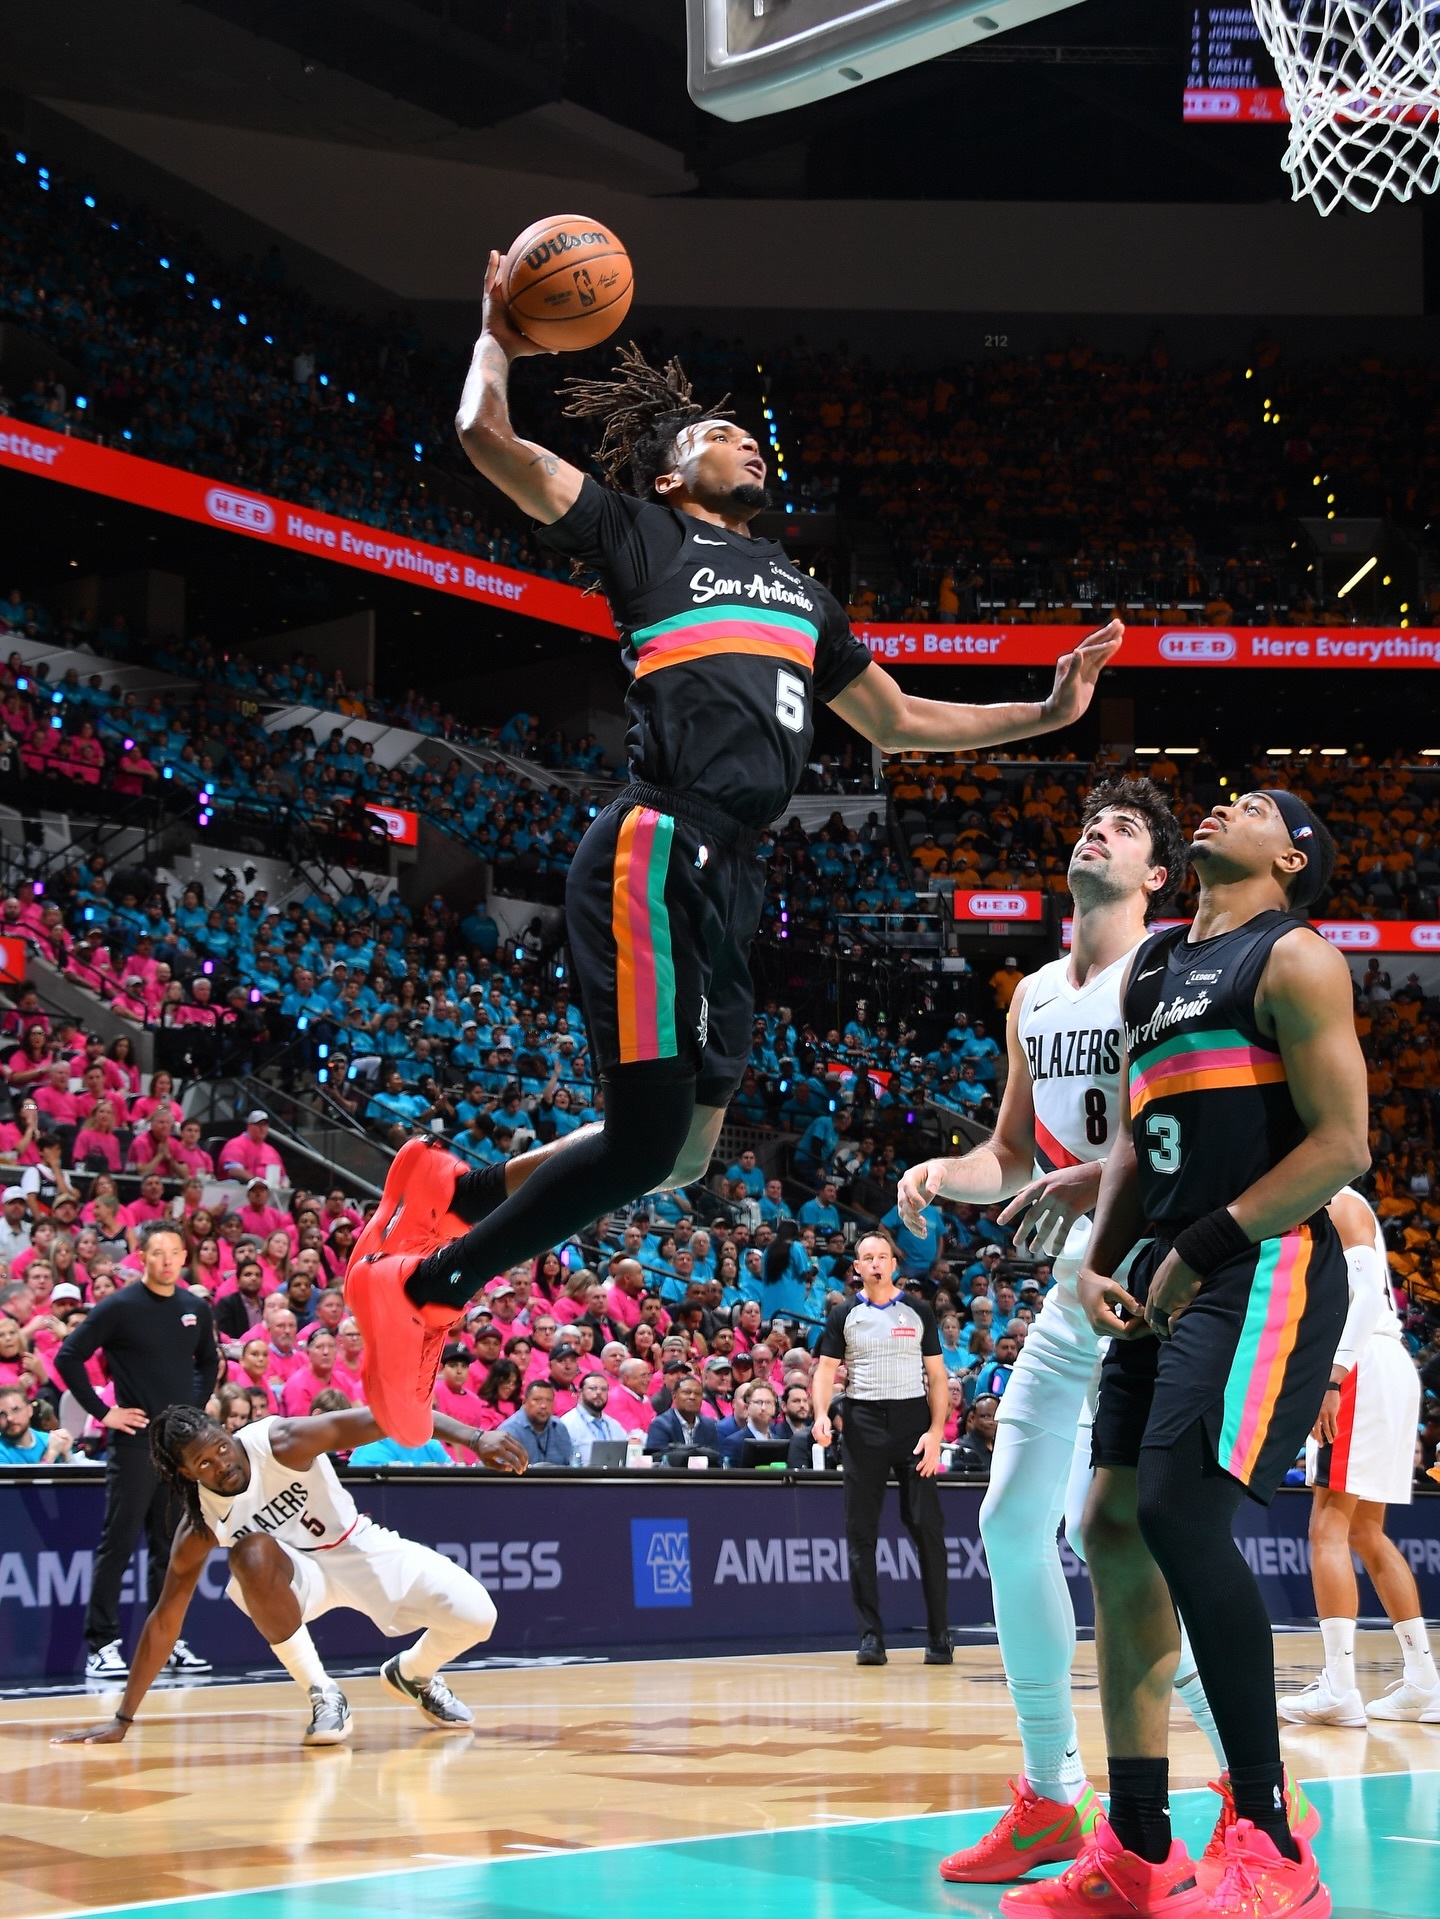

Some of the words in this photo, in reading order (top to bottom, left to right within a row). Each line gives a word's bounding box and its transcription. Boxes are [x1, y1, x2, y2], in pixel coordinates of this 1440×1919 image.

[1208, 26, 1261, 39] JOHNSO
[523, 232, 609, 270] Wilson
[984, 335, 1008, 347] 212
[287, 515, 335, 547] Here
[341, 531, 459, 584] Everything's
[464, 567, 523, 600] Better
[690, 567, 742, 603] San
[744, 574, 814, 612] Antonio
[923, 634, 1000, 653] Better
[1252, 637, 1309, 656] Here
[775, 668, 805, 733] 5
[1190, 973, 1217, 981] LEDGER
[1141, 990, 1213, 1041] Antonio
[1025, 1029, 1121, 1081] BLAZERS
[1084, 1088, 1108, 1145] 8
[1146, 1113, 1182, 1175] 3
[300, 1510, 326, 1538] 5
[646, 1532, 690, 1566] AM
[713, 1538, 922, 1584] AMERIAN
[653, 1563, 692, 1594] EX
